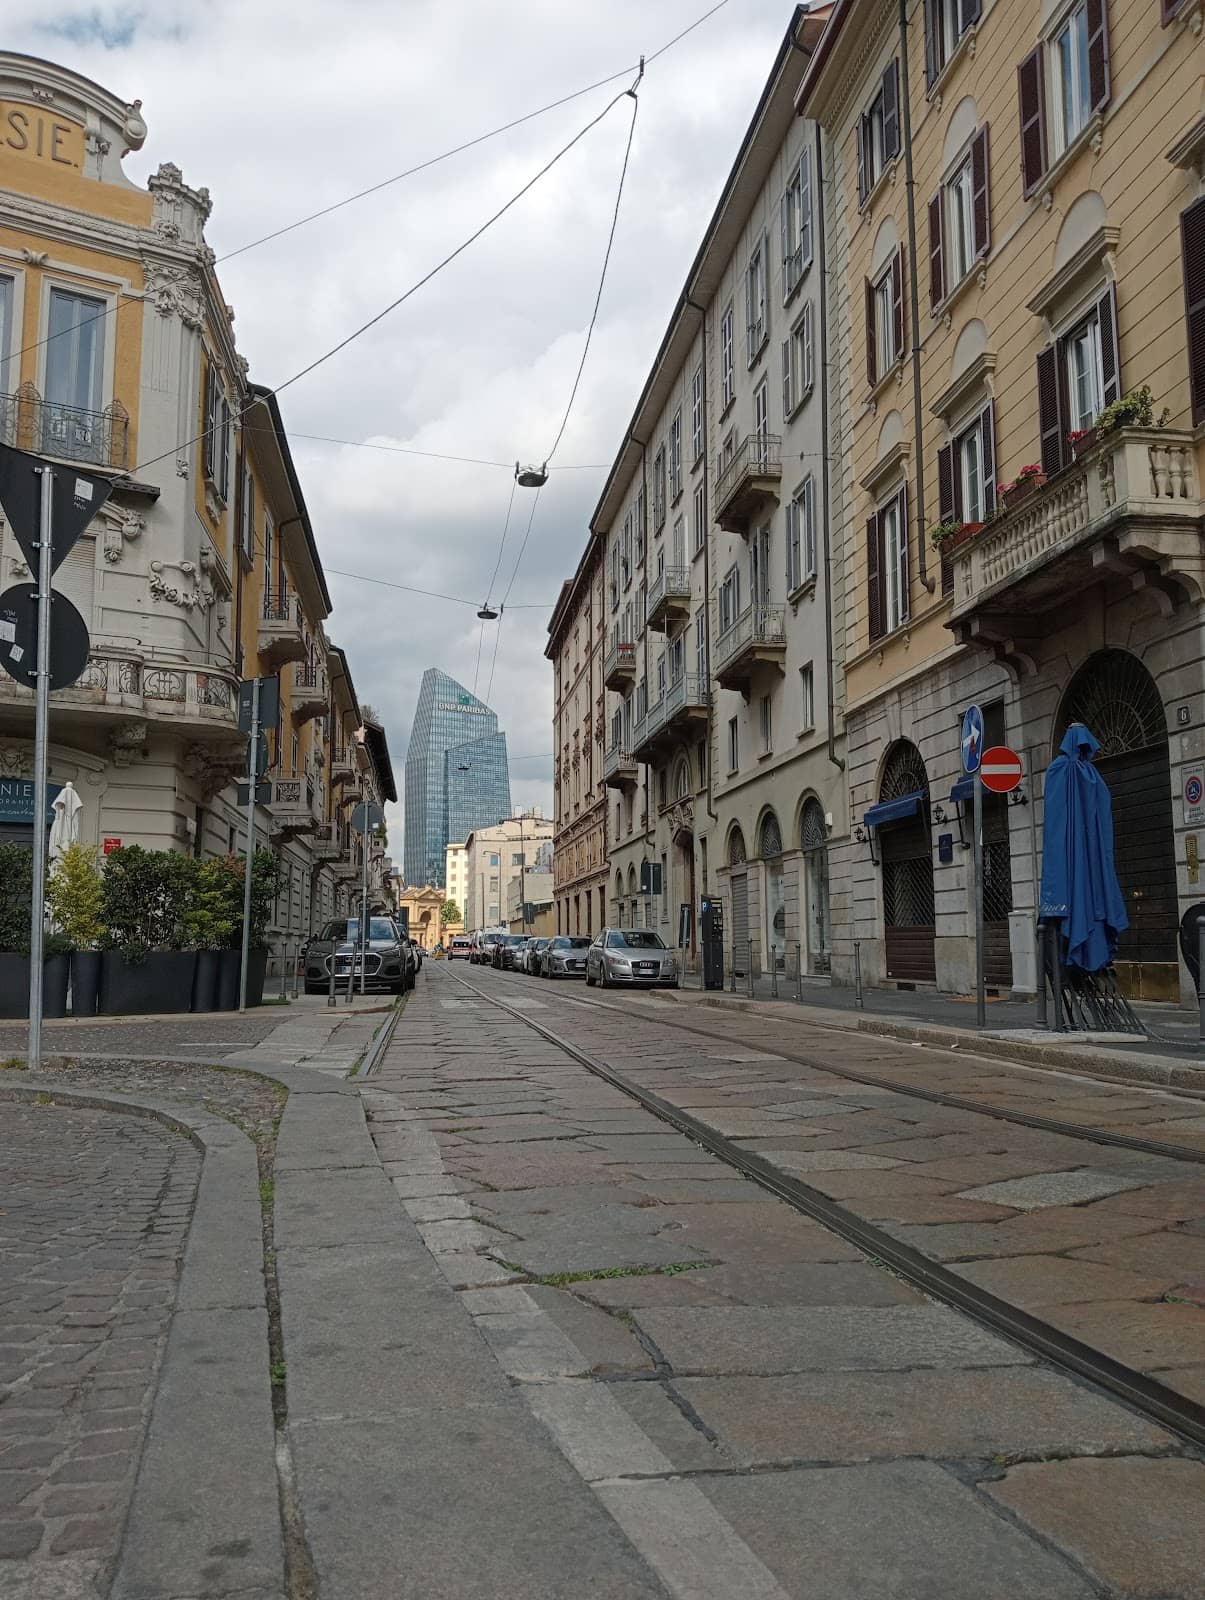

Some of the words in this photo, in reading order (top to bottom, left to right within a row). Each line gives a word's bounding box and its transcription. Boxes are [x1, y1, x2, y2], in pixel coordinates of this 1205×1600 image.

[0, 110, 79, 168] SIE.
[439, 702, 457, 712] BNP
[457, 704, 491, 716] PARIBAS
